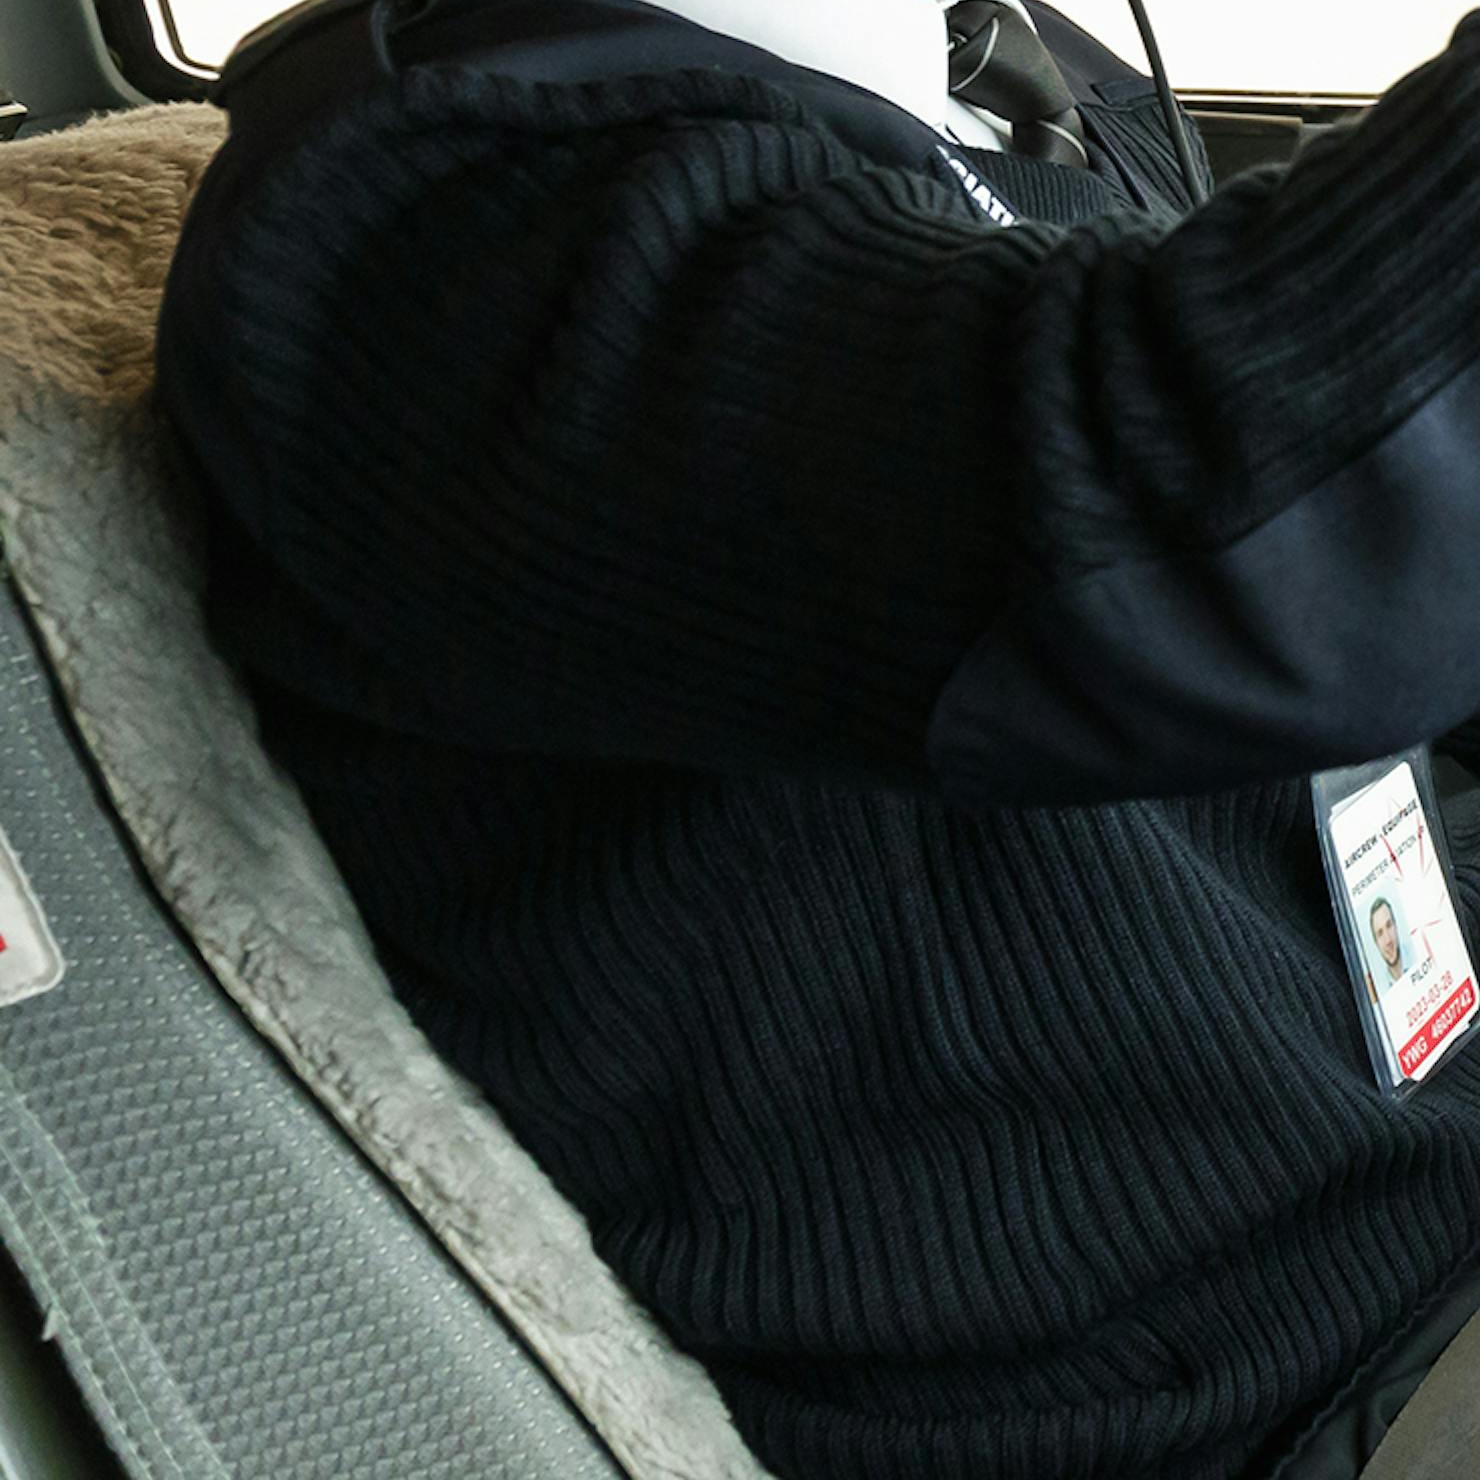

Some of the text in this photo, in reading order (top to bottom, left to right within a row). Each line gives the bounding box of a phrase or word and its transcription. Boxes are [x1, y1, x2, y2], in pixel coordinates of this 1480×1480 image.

[1344, 834, 1378, 869] AIRCREW
[1411, 957, 1434, 987] PILOT
[1401, 1034, 1429, 1071] YWG
